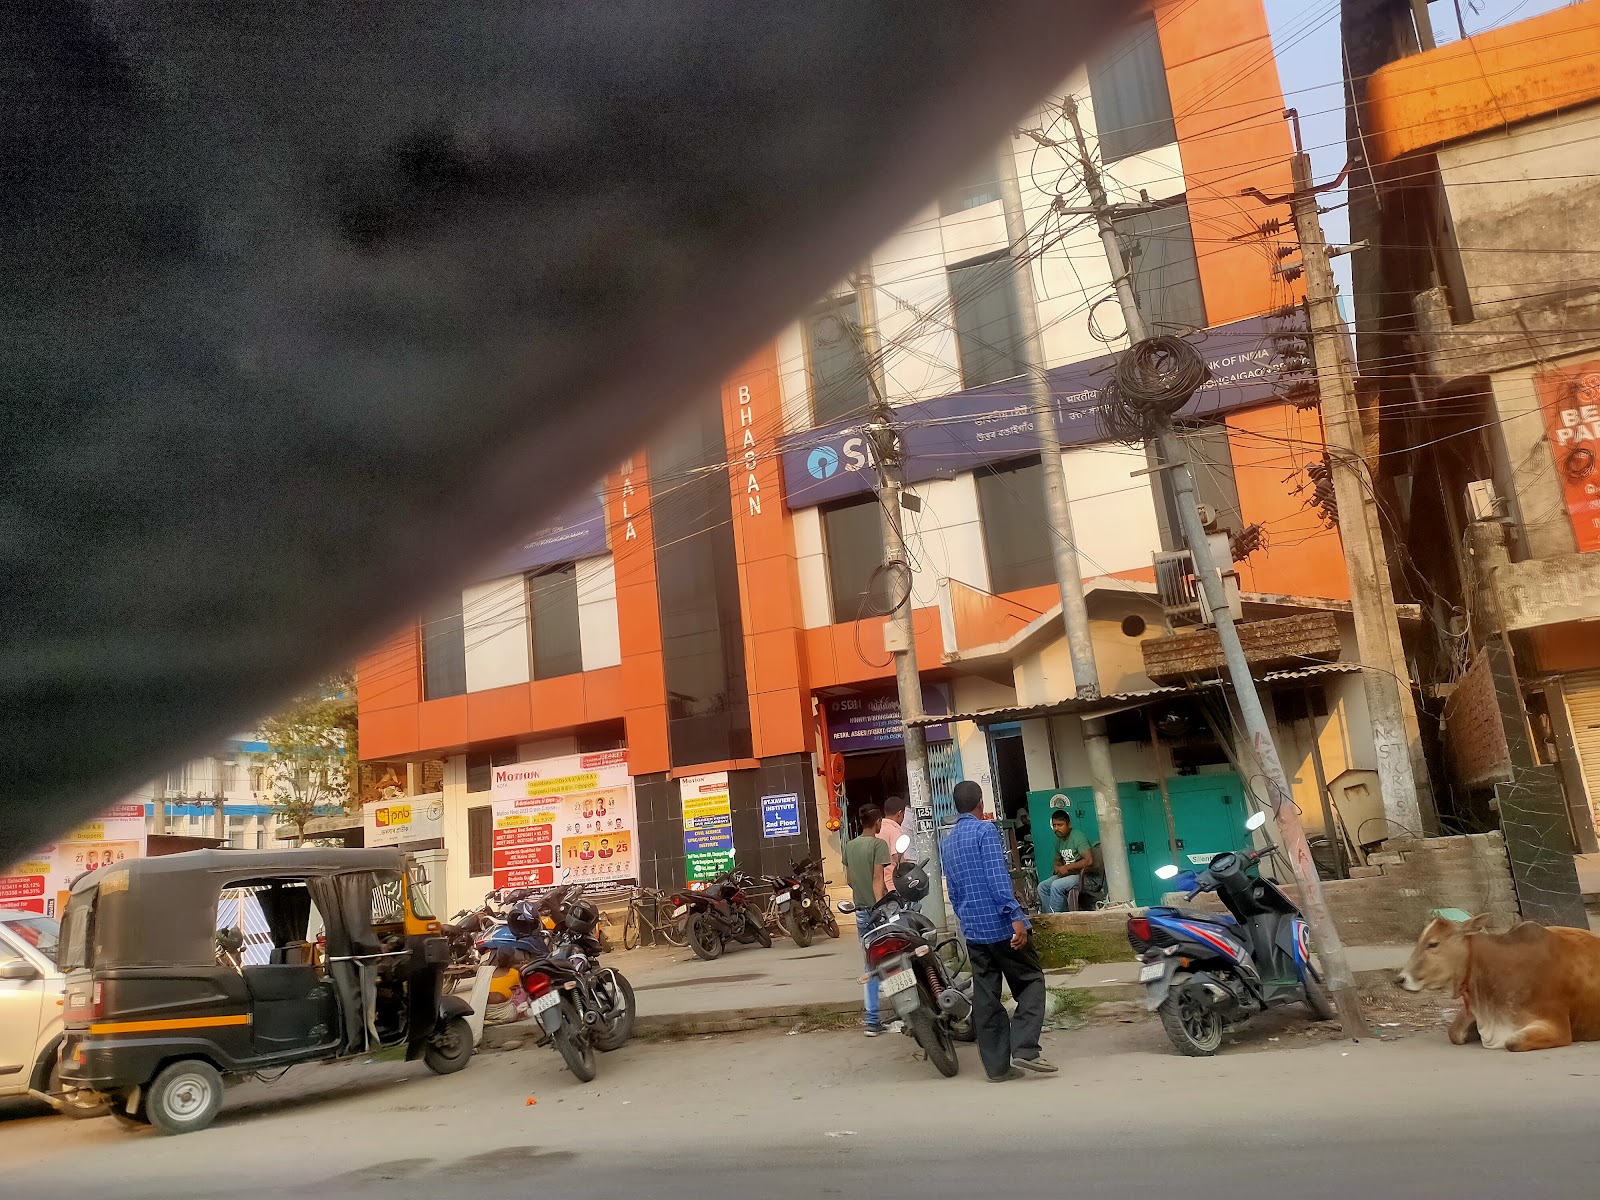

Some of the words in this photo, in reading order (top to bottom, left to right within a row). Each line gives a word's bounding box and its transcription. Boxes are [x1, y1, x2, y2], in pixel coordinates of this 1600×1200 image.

[1222, 356, 1237, 367] OF
[1239, 348, 1270, 363] INDIA
[765, 804, 795, 812] INSTITUTE
[391, 807, 410, 824] pnb
[766, 820, 778, 828] 2nd
[616, 843, 628, 853] 25
